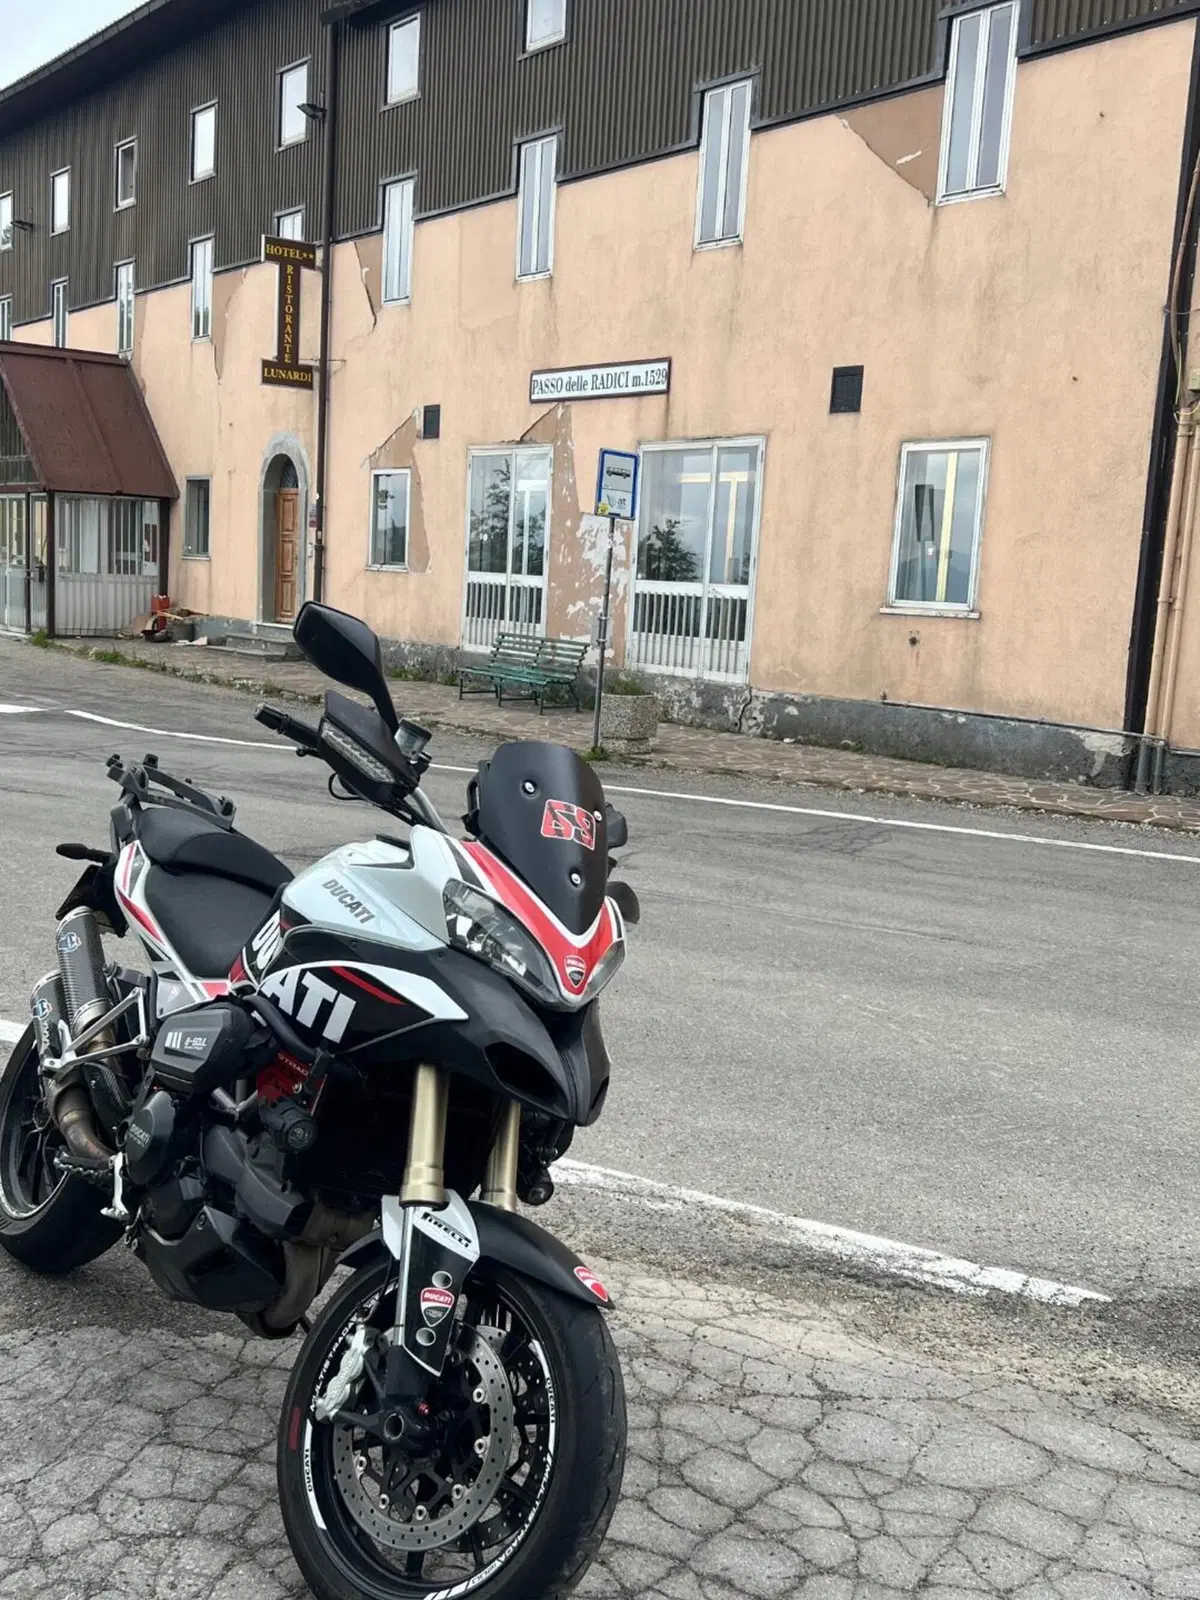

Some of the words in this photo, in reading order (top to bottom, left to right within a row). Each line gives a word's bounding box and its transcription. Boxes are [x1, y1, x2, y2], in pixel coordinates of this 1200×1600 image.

[266, 244, 302, 260] HOTEL
[284, 264, 294, 363] RISTORANTE
[264, 367, 312, 382] LUNARDI
[532, 377, 564, 395] PASSO
[565, 375, 588, 392] delle
[591, 370, 629, 391] RADICI
[632, 368, 668, 388] m.1529
[322, 879, 376, 925] DUCATI
[423, 1291, 452, 1304] DUCATI
[304, 1448, 313, 1492] DUCATI
